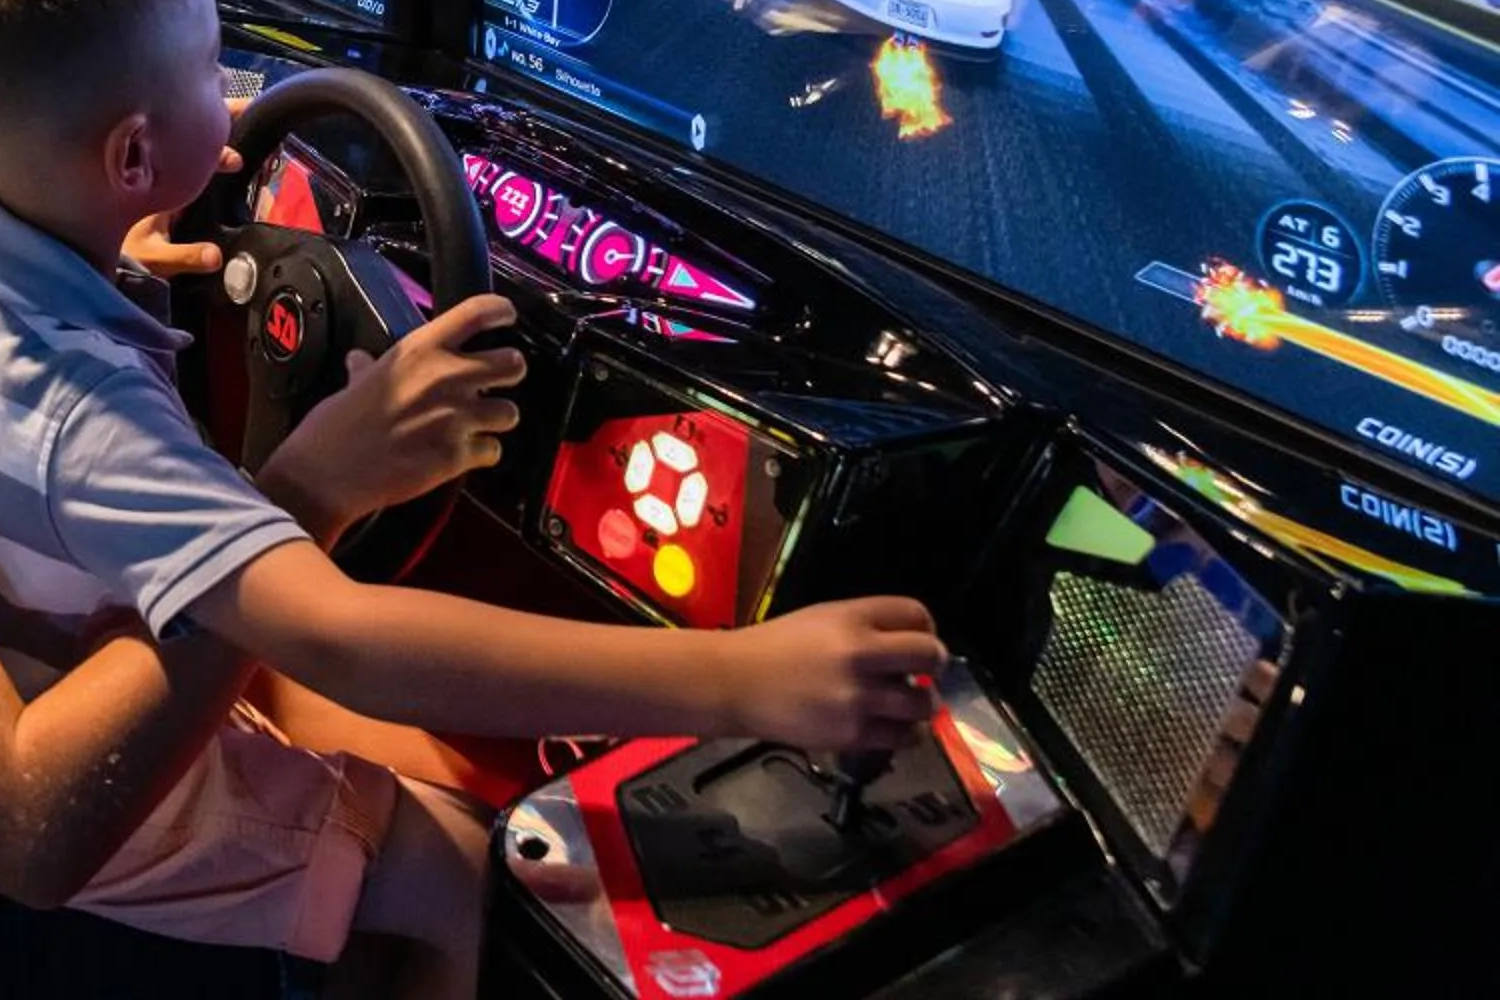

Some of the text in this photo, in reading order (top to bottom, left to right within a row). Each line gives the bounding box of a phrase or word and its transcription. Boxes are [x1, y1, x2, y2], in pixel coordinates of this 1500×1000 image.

[1432, 185, 1450, 206] 3
[1471, 183, 1490, 202] 4
[1278, 214, 1341, 249] AT 6
[1402, 215, 1422, 239] 2
[1271, 242, 1342, 293] 273
[1355, 416, 1478, 480] COIN(S)
